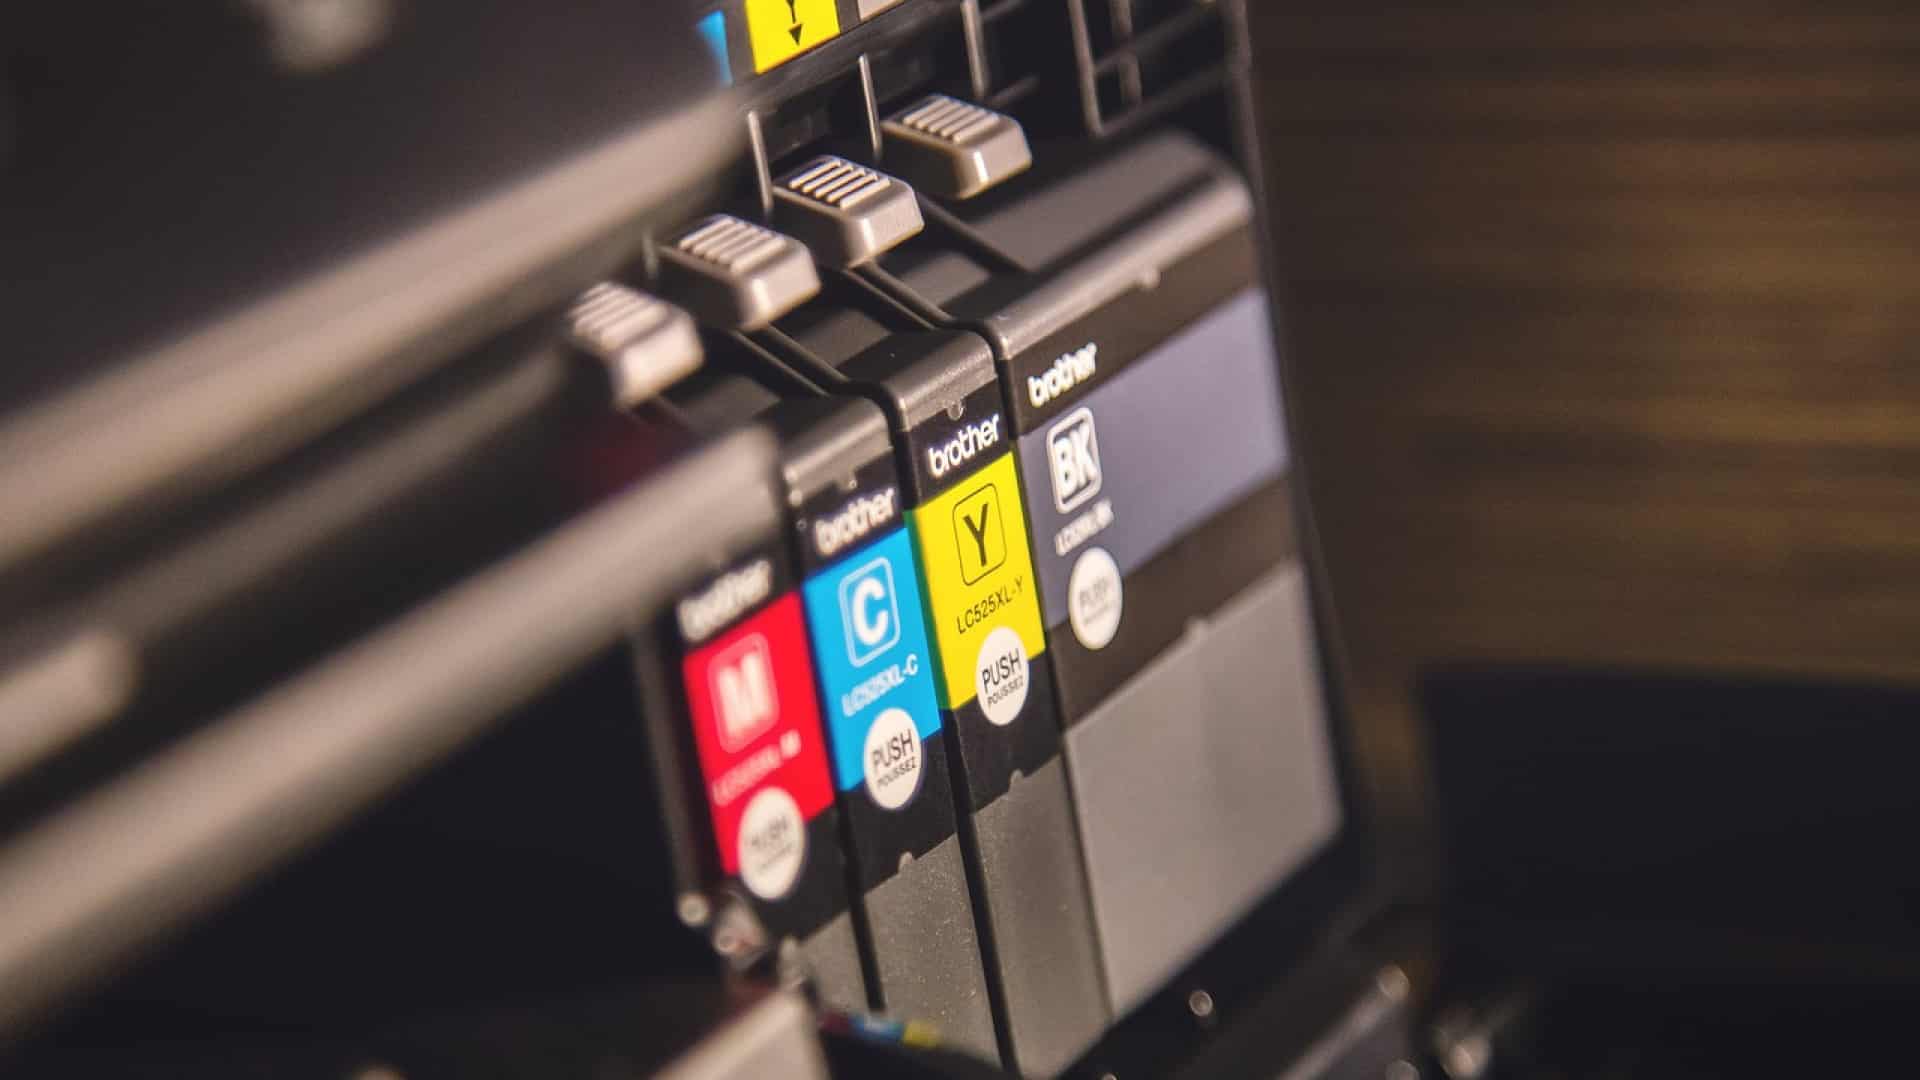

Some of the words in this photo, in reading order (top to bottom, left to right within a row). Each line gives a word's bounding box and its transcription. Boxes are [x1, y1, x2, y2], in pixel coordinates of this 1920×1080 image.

[1027, 341, 1098, 408] brother
[928, 413, 1000, 478] brother
[1054, 422, 1098, 498] BK
[814, 488, 895, 555] brother
[963, 503, 988, 567] Y
[853, 577, 888, 645] C
[956, 576, 1022, 634] LC525XL-Y
[716, 649, 774, 738] M
[982, 647, 1022, 694] PUSH
[872, 728, 915, 774] PUSH
